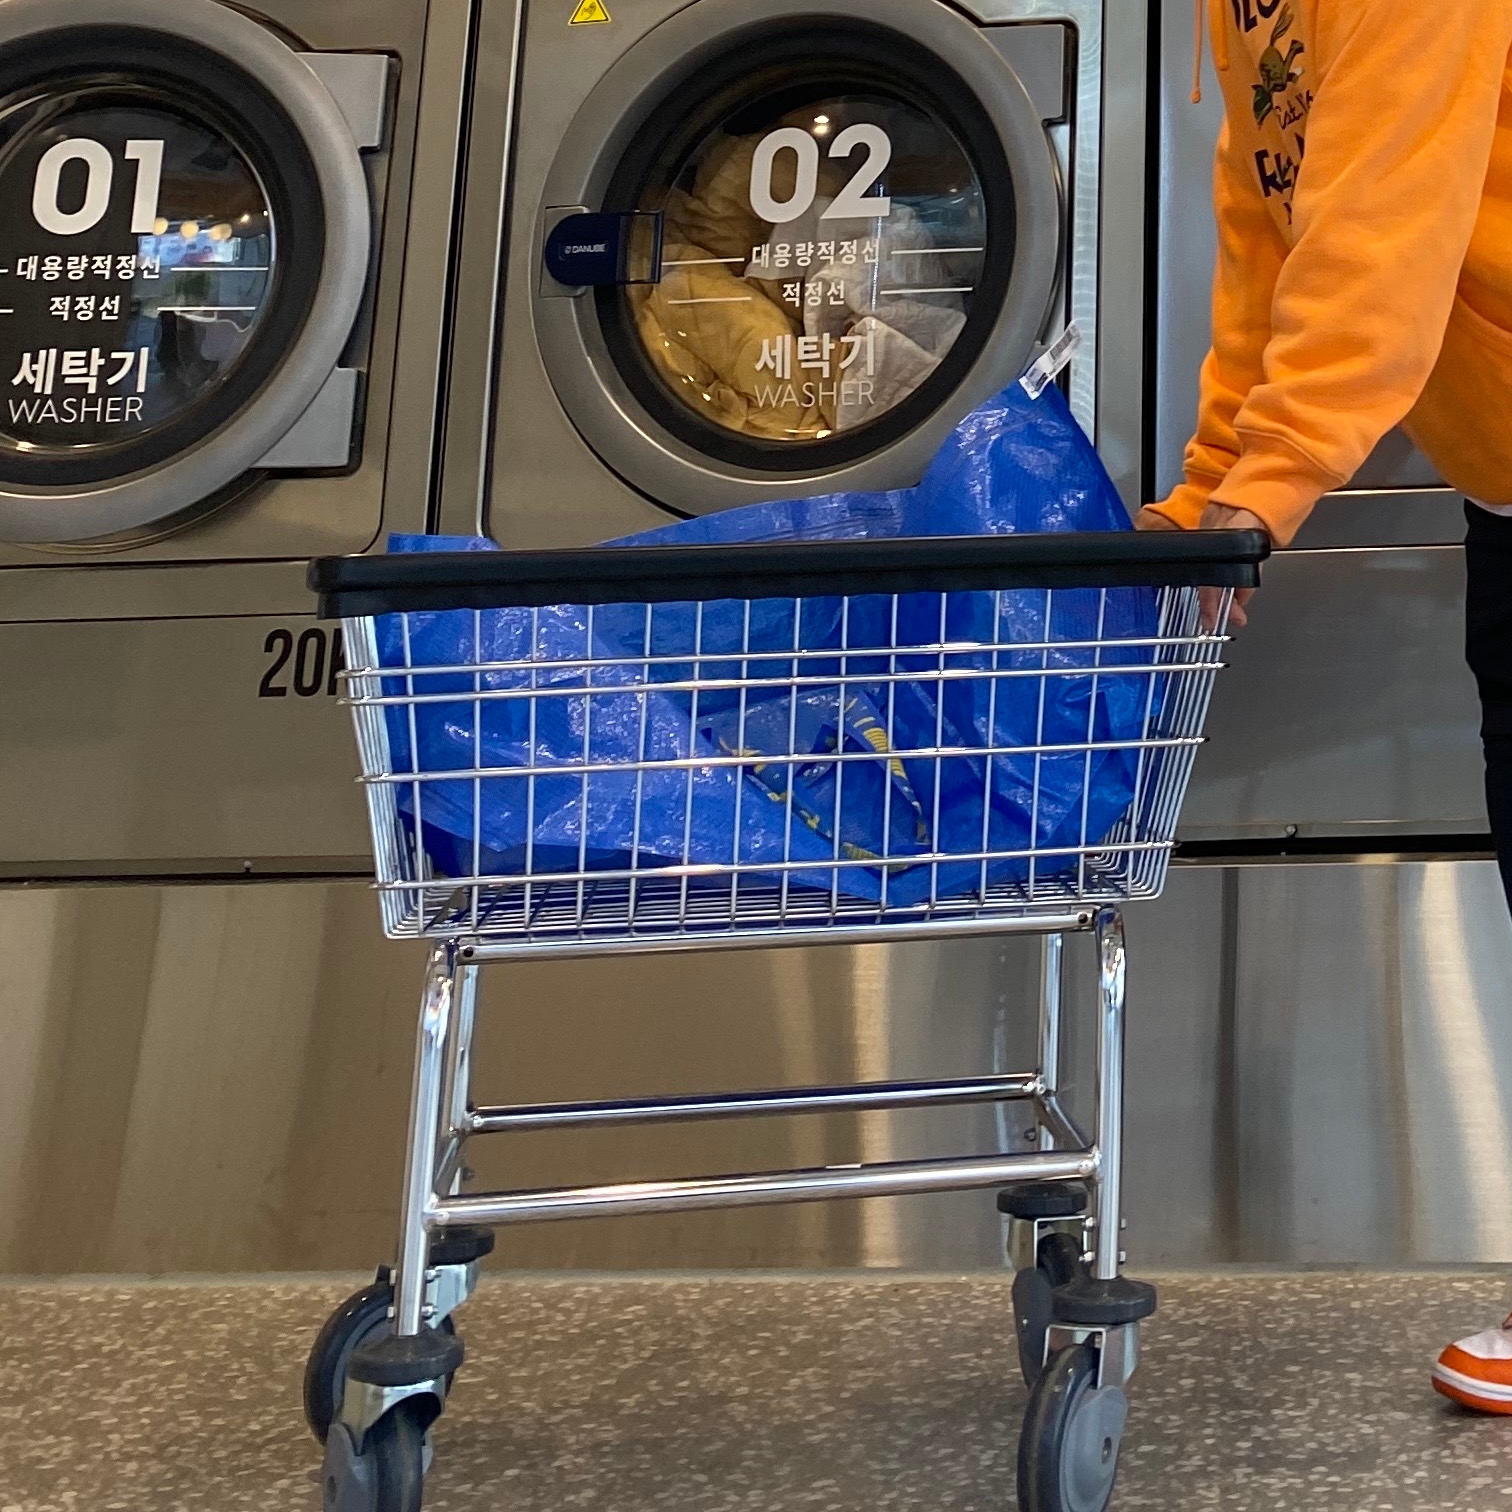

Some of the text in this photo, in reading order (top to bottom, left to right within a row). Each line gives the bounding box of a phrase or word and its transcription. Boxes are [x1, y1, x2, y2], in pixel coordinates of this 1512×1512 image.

[32, 138, 164, 235] 01
[749, 123, 892, 224] 02
[15, 254, 161, 281] 대용량적정선
[752, 239, 881, 268] 대용량적정선
[49, 295, 121, 321] 적정선
[783, 281, 847, 307] 적정선
[755, 332, 875, 380] 세탁기
[11, 347, 149, 395] 세탁기
[753, 381, 875, 410] WASHER
[8, 397, 143, 424] WASHER
